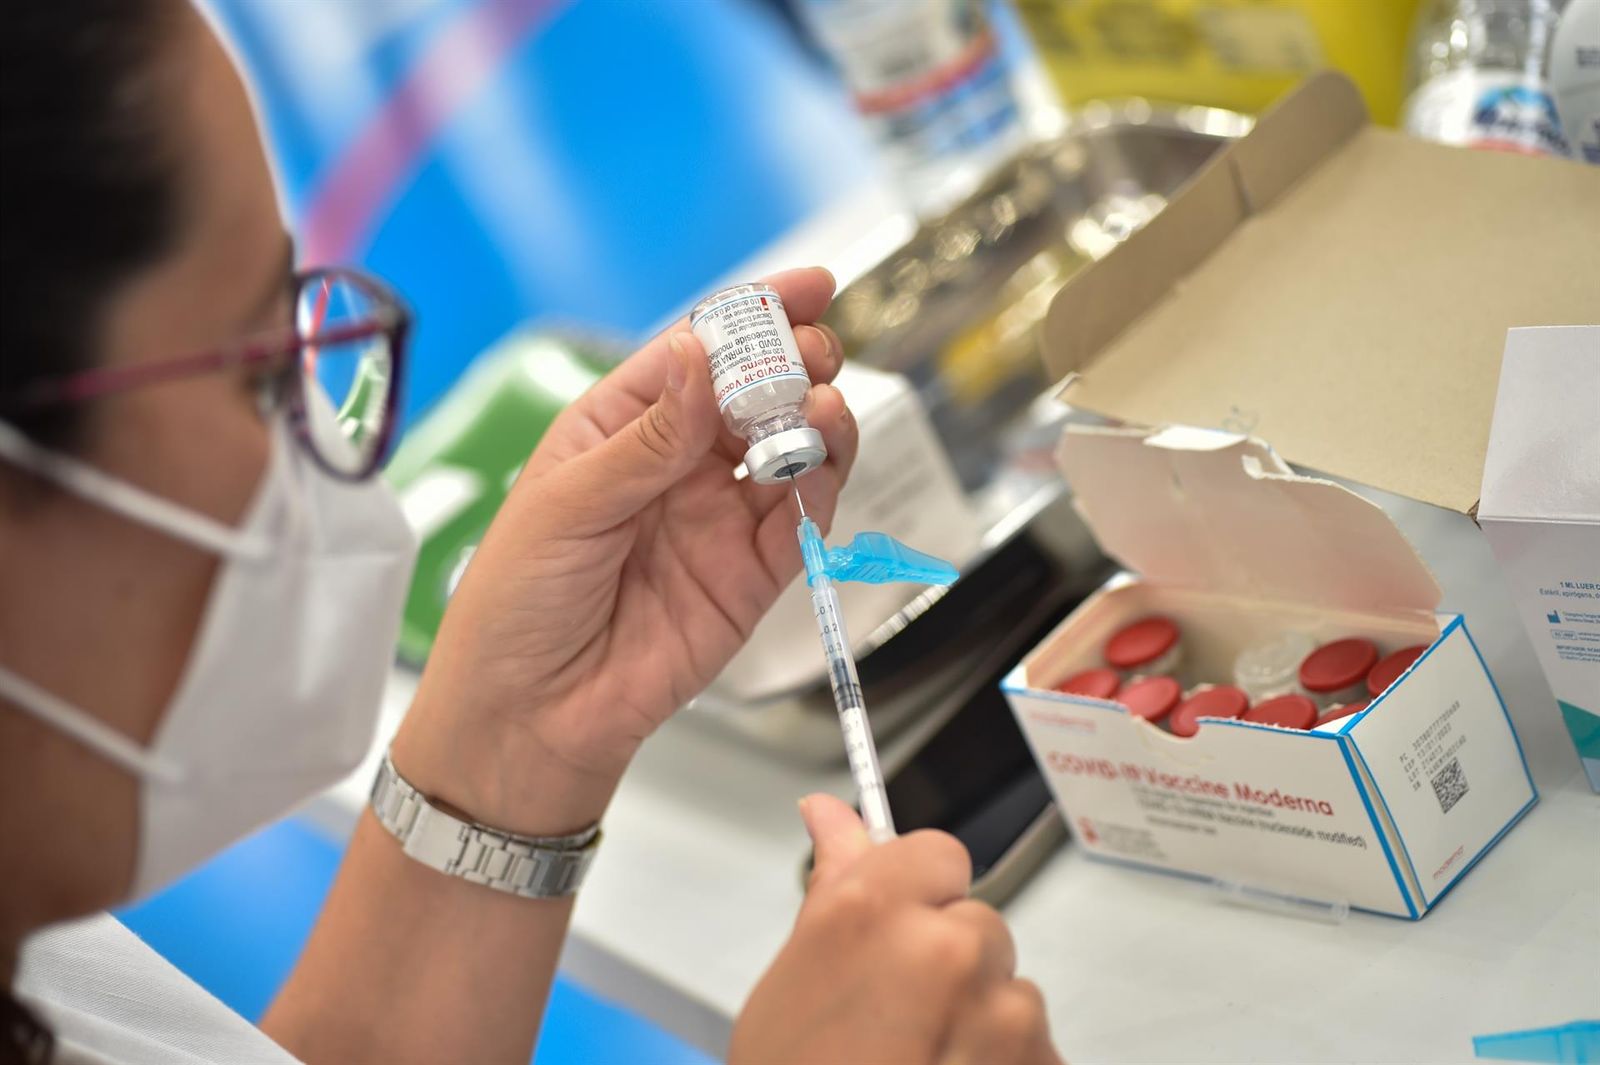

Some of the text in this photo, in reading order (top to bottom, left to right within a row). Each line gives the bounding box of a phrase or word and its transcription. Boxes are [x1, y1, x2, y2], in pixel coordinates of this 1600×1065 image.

[727, 328, 738, 336] Use
[736, 328, 779, 345] (nucleoside
[722, 348, 744, 364] mRNA
[740, 354, 787, 373] Moderna
[744, 364, 790, 384] COVID-19
[1047, 751, 1142, 781] COVID-19
[1148, 766, 1230, 799] Vaccine
[1234, 782, 1335, 816] Moderna
[1316, 828, 1368, 850] modified)
